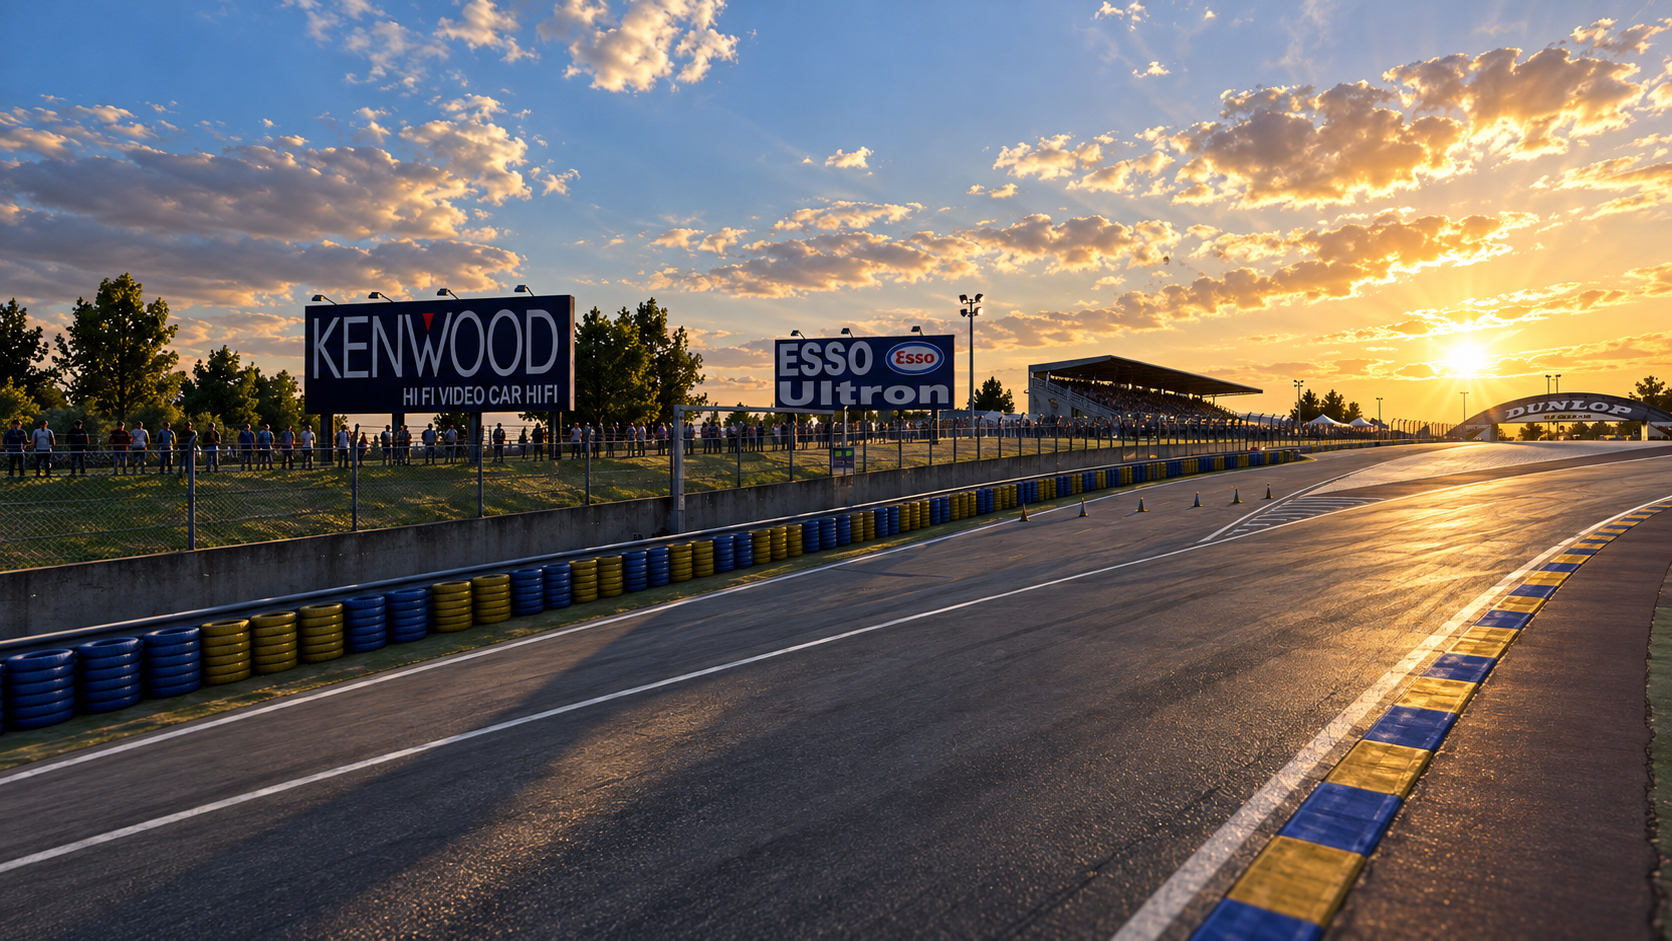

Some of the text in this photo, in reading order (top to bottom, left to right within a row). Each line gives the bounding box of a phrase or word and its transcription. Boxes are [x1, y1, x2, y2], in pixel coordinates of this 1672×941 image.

[313, 308, 559, 379] KENWOOD
[779, 340, 873, 377] ESSO
[895, 350, 935, 365] Esso
[403, 384, 558, 406] HI FI VIDEO CAR HI FI
[779, 380, 949, 406] Ultron
[1505, 400, 1632, 419] DUNLOP
